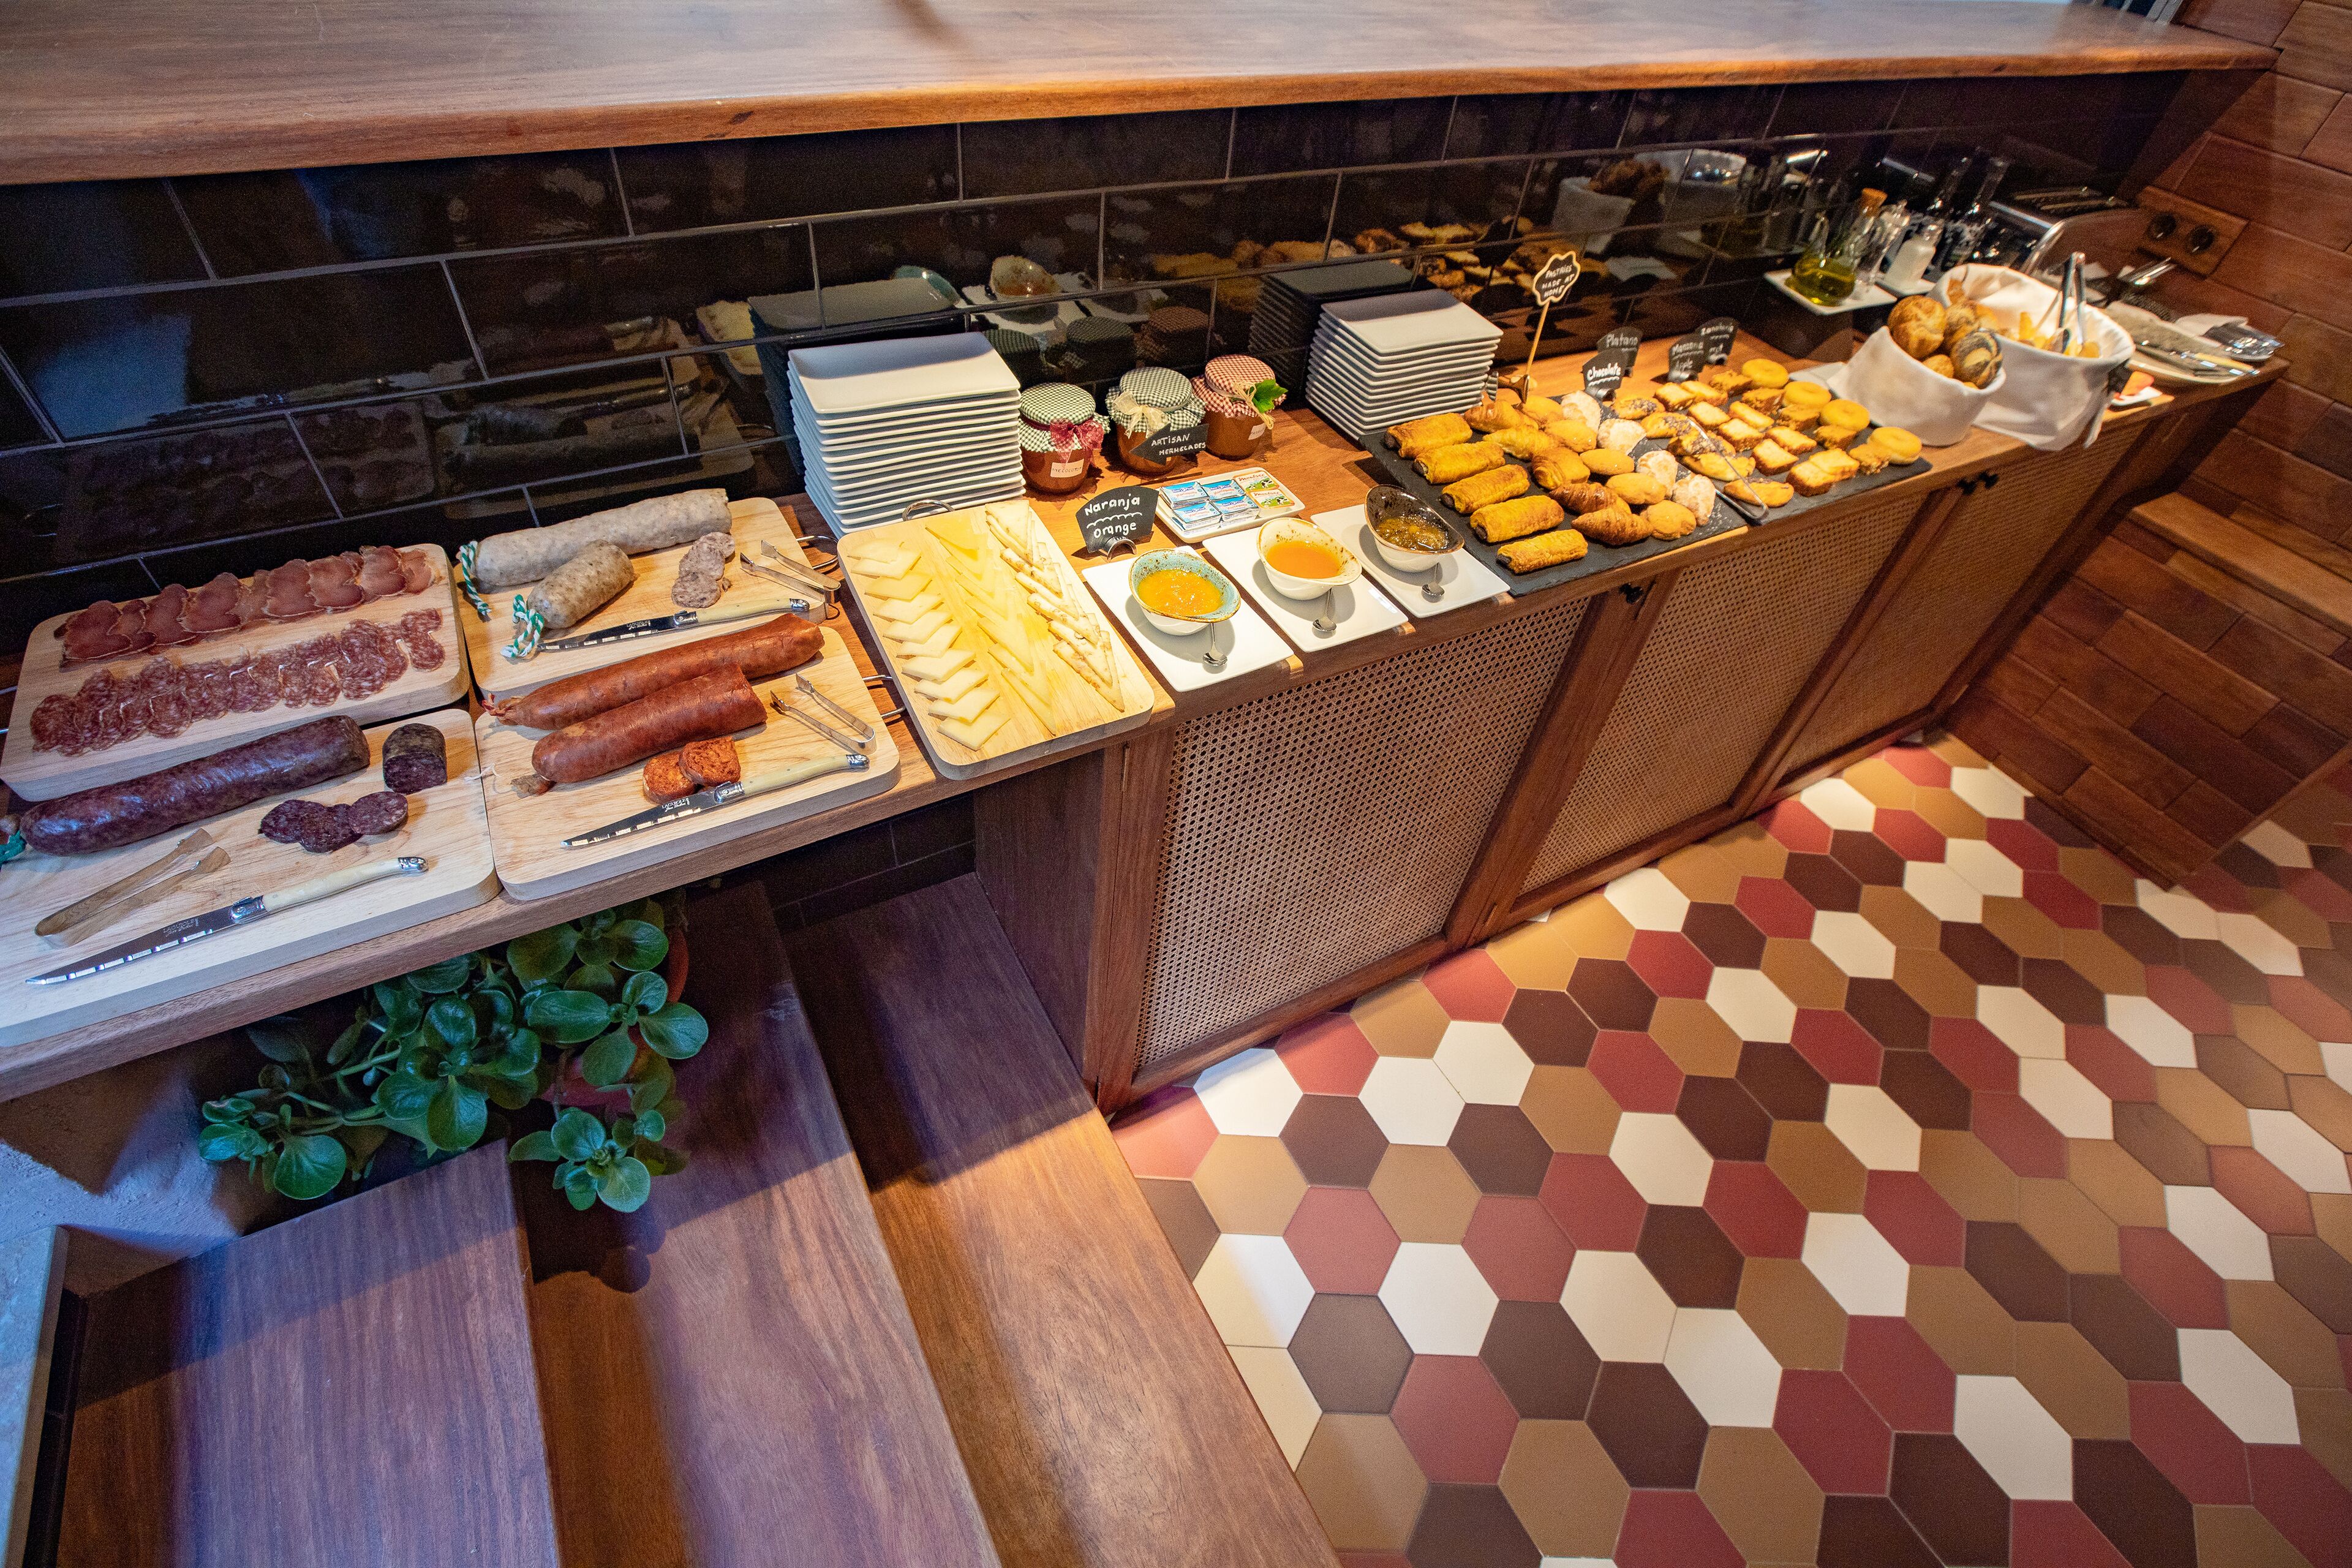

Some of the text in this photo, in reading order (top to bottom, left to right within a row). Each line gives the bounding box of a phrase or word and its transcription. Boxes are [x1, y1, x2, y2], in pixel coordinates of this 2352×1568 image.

[1545, 265, 1573, 279] PASTRIES
[1542, 273, 1575, 289] MADE AT
[1544, 285, 1565, 298] HOME
[1587, 363, 1622, 381] Chocolate
[1084, 493, 1140, 516] Naranja
